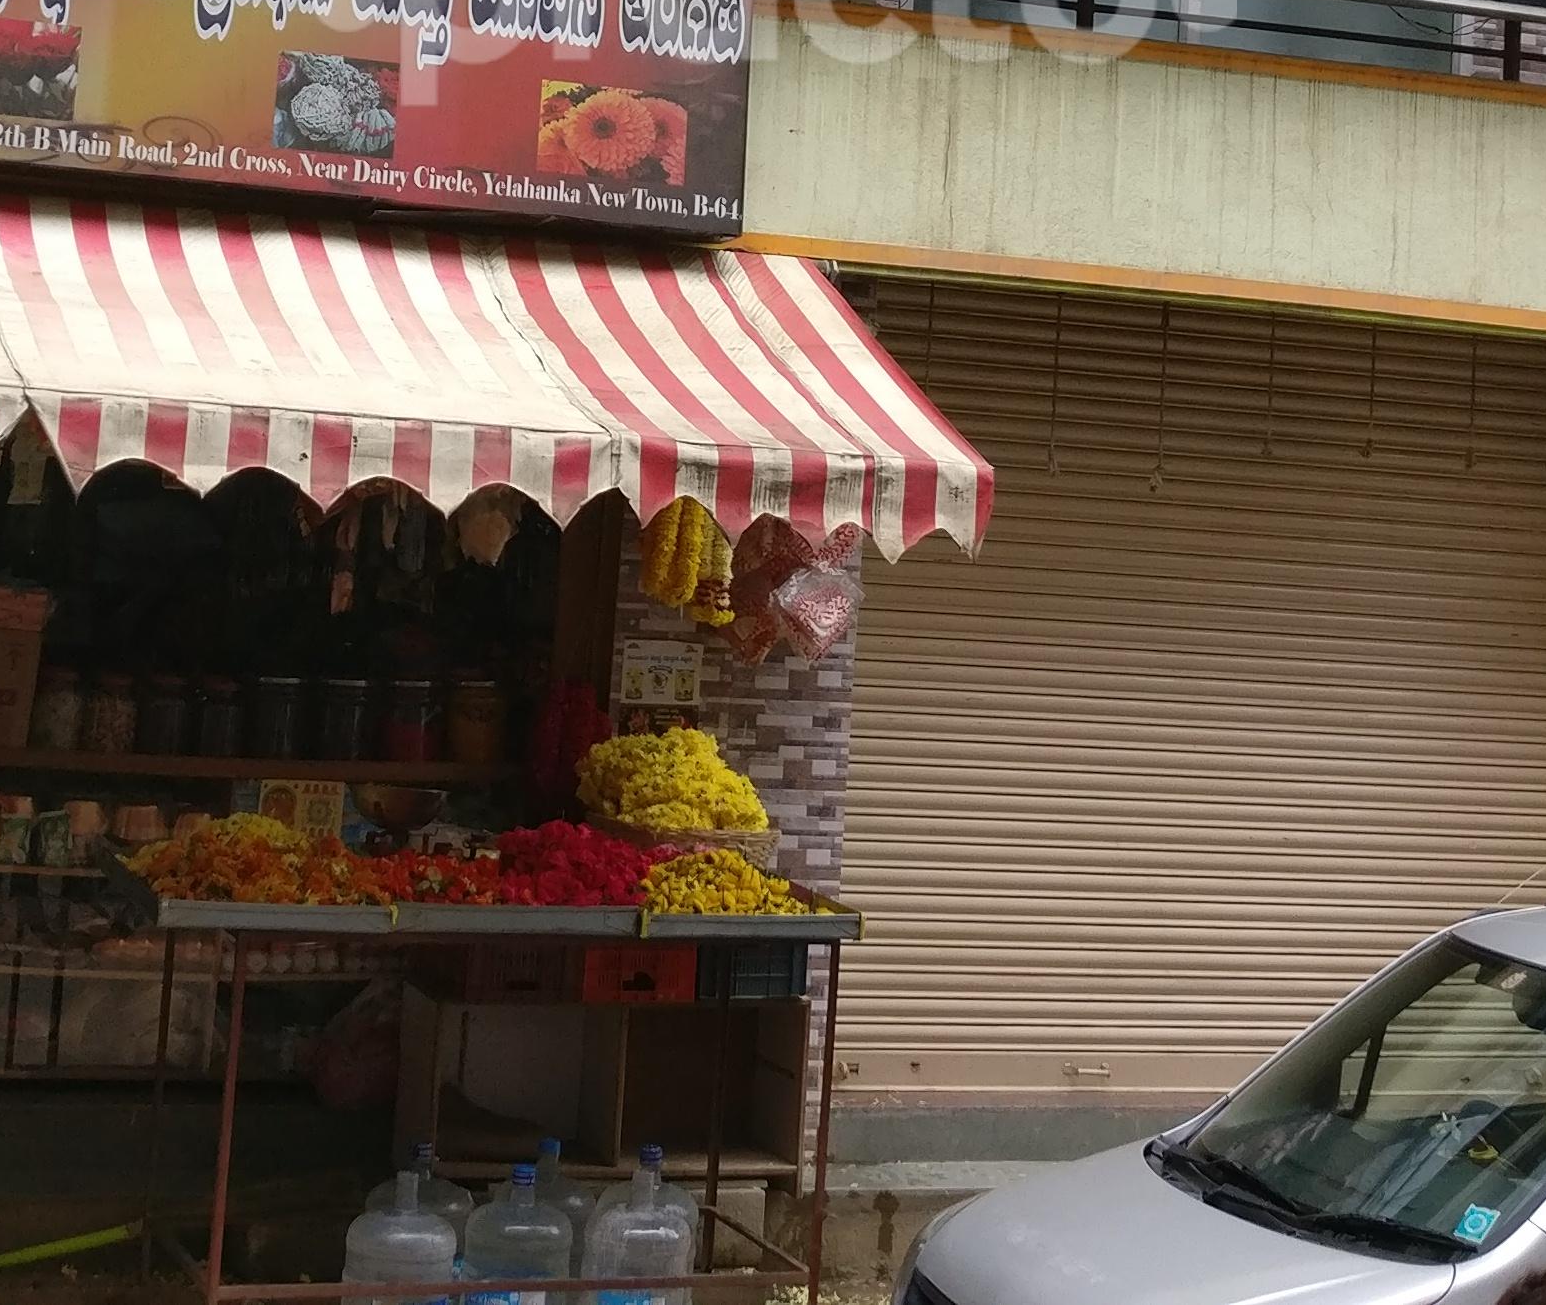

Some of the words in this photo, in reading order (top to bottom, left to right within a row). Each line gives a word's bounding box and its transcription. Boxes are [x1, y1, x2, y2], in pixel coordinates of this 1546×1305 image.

[32, 126, 52, 152] B
[55, 128, 113, 159] Main
[116, 135, 179, 168] Road,
[182, 141, 225, 170] 2nd
[230, 147, 293, 178] Cross,
[297, 152, 349, 182] Near
[352, 157, 410, 193] Dairy
[413, 164, 479, 197] Circle,
[483, 171, 582, 206] Yelahanka
[586, 181, 631, 211] New
[631, 186, 689, 219] Town,
